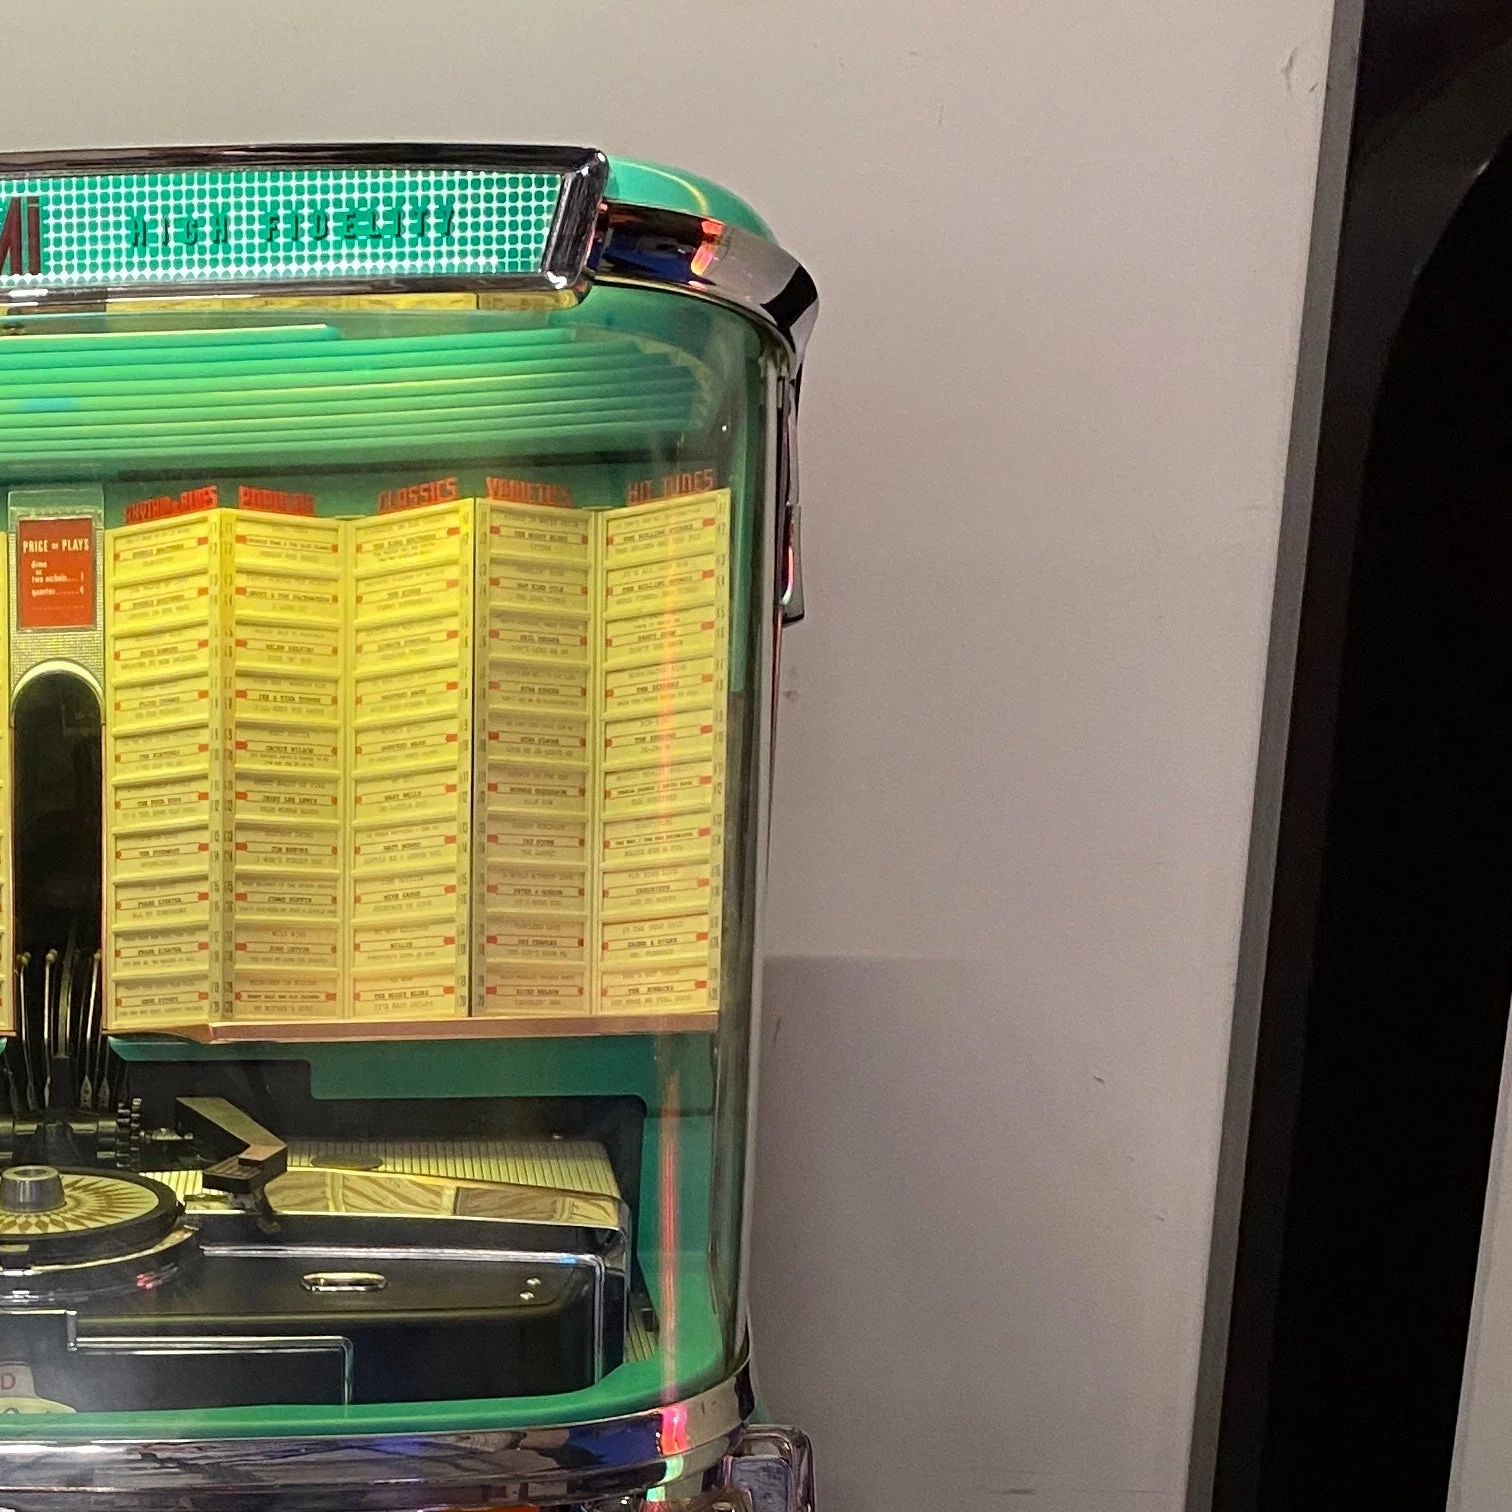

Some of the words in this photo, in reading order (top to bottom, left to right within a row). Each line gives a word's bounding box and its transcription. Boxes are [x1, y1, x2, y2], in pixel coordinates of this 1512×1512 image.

[130, 210, 229, 247] HIGH
[266, 203, 455, 243] FIDELITY
[23, 540, 48, 553] PRICE
[62, 538, 89, 551] PLAYS
[0, 1373, 16, 1390] D
